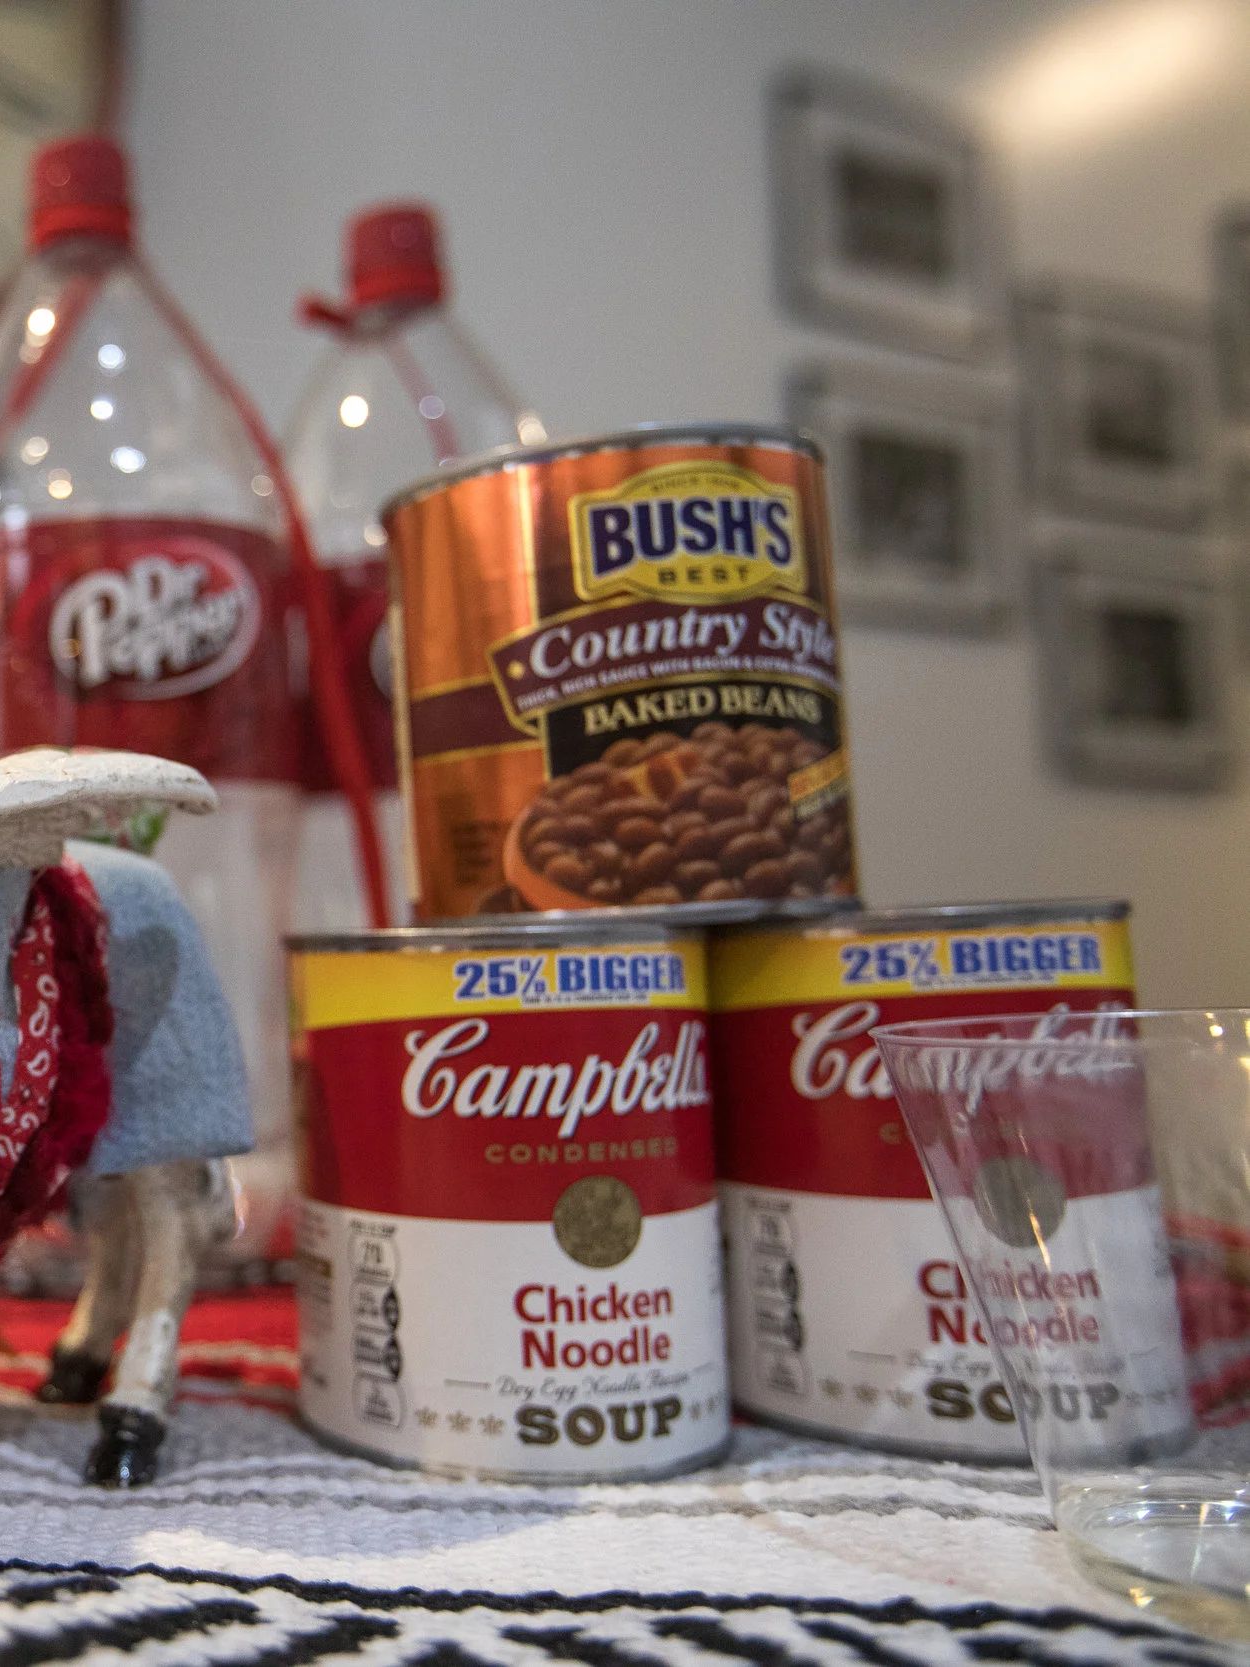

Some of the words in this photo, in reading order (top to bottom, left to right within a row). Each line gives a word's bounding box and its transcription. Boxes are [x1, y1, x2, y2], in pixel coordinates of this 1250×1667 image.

[589, 498, 791, 578] BUSH'S
[658, 564, 750, 586] BEST
[529, 607, 748, 678] Country
[584, 687, 717, 735] BAKED
[720, 685, 823, 724] BEANS
[454, 957, 547, 999] 25%
[558, 953, 687, 993] BIGGER
[841, 941, 940, 984] 25%
[953, 934, 1102, 975] BIGGER
[485, 1136, 678, 1164] CONDENSED
[513, 1282, 672, 1324] Chicken
[521, 1324, 672, 1368] Noodle
[515, 1394, 683, 1446] SOUP
